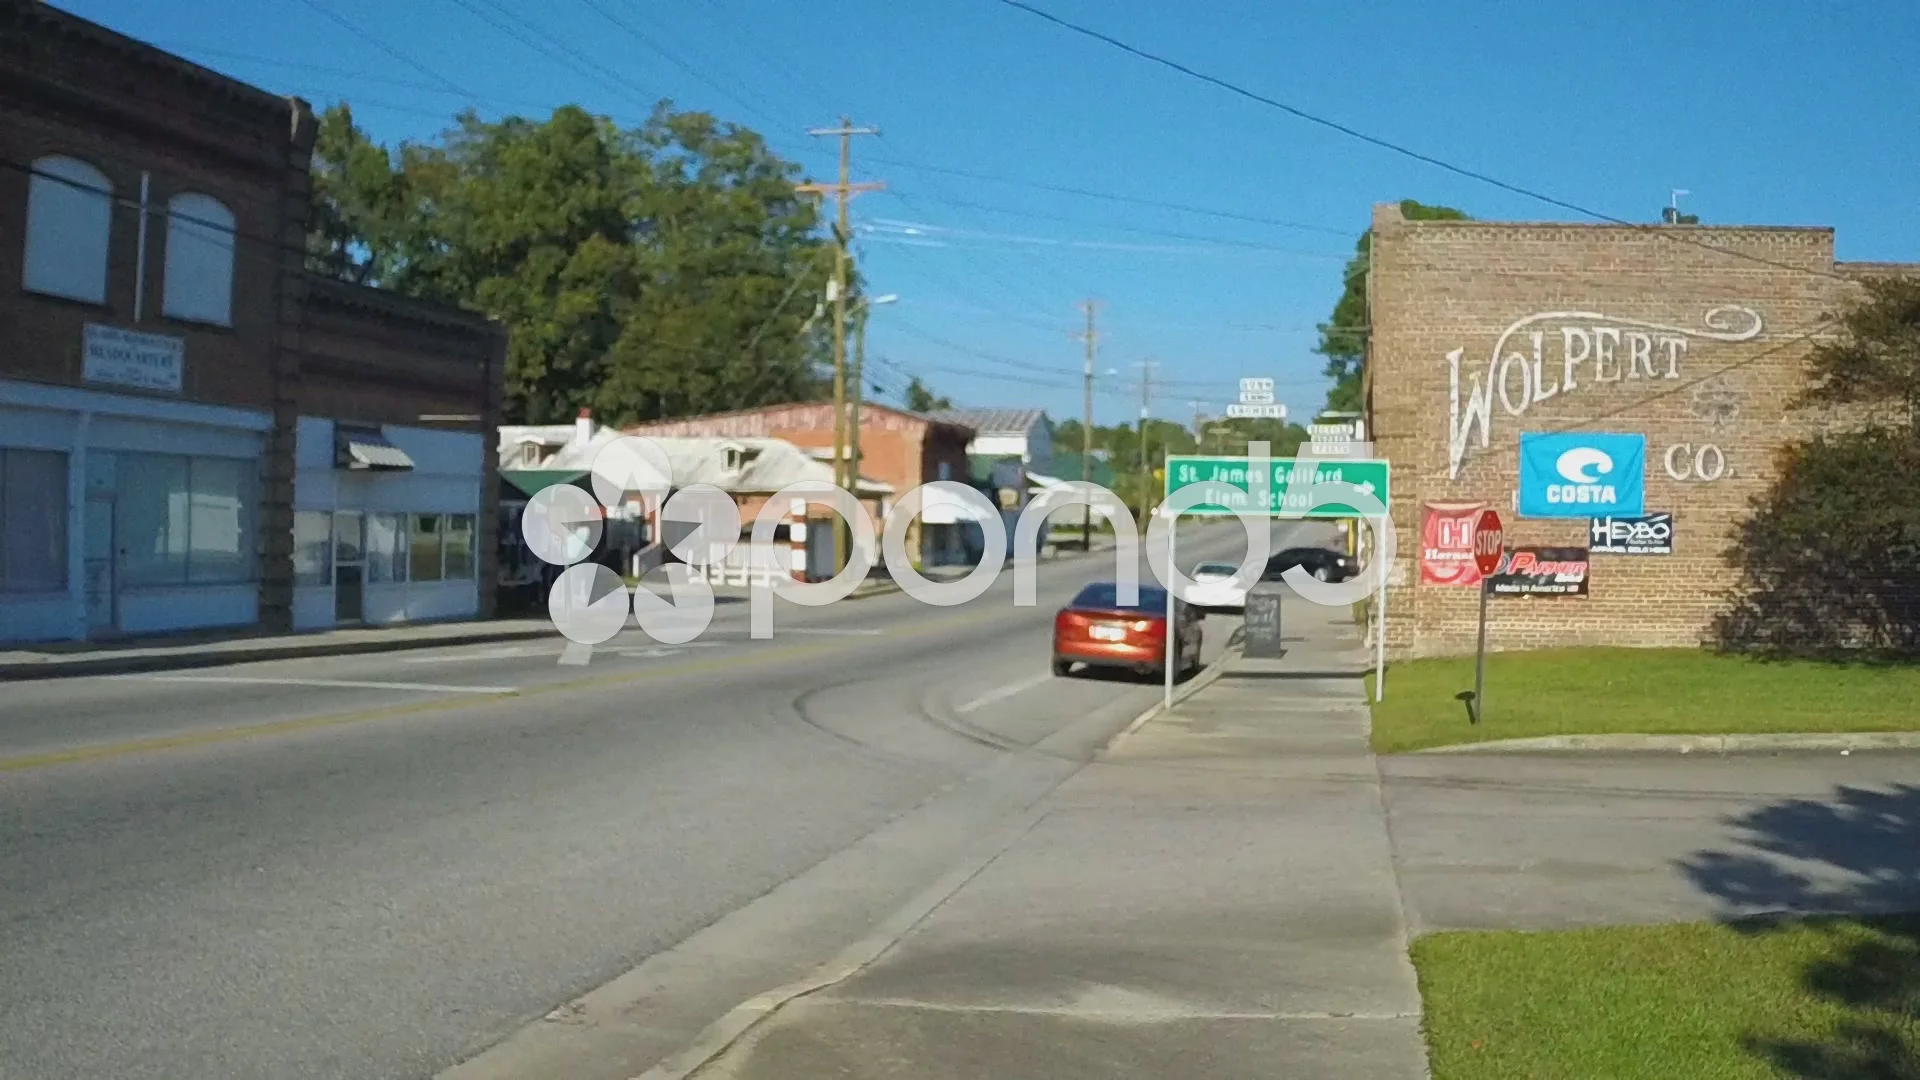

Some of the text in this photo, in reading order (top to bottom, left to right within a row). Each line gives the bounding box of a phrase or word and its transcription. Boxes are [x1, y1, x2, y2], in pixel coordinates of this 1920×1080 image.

[1446, 311, 1762, 480] WOLPERT
[1209, 465, 1264, 484] James
[1258, 490, 1313, 508] School
[1546, 484, 1616, 505] COSTA
[1475, 530, 1501, 556] STOP
